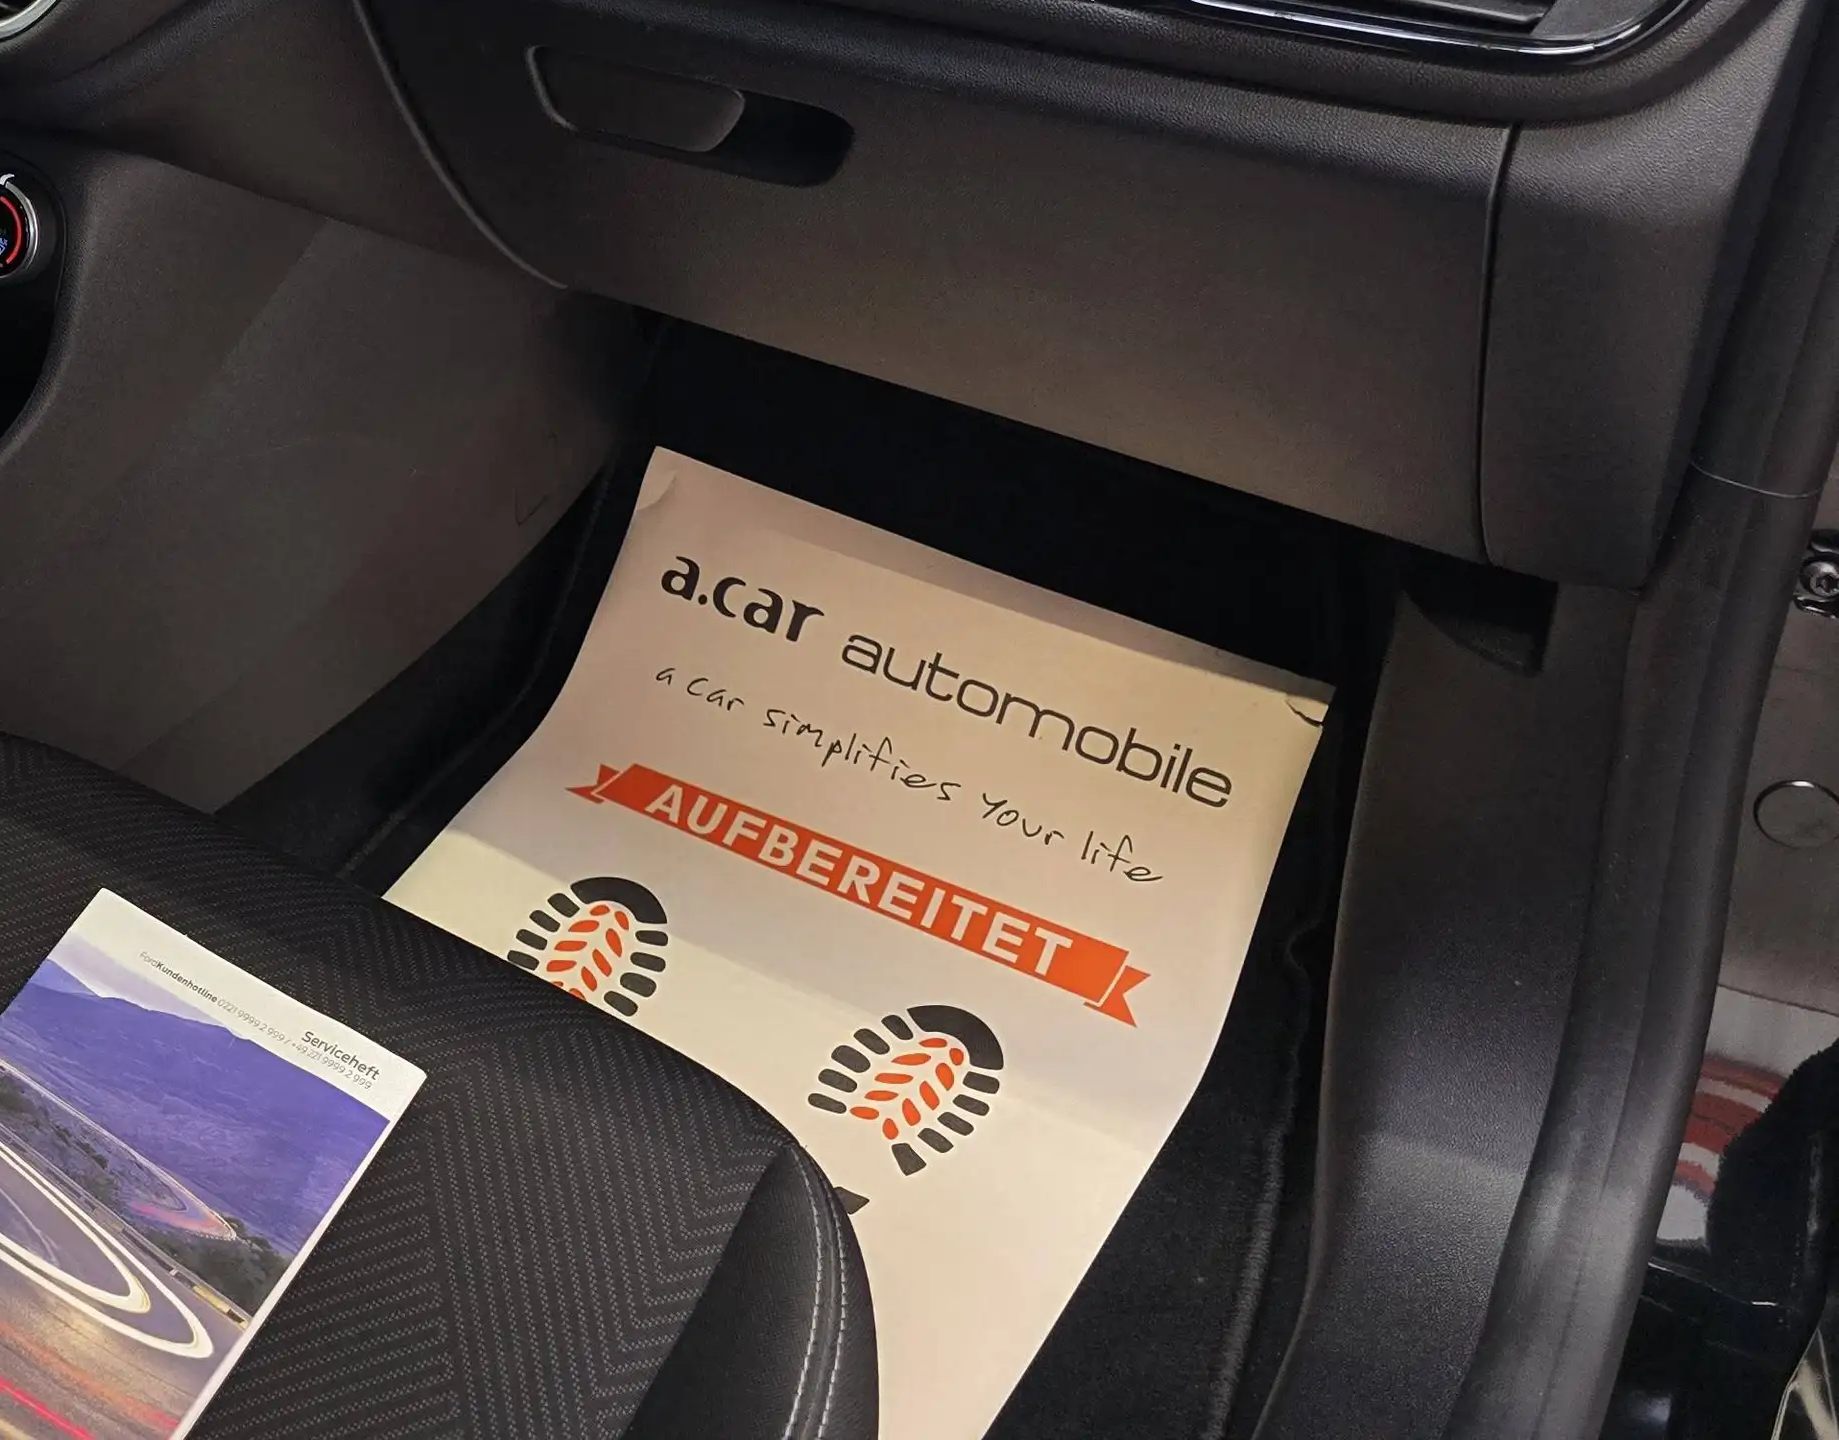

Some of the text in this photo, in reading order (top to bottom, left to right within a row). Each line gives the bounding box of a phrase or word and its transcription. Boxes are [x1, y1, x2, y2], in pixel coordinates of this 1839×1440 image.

[655, 667, 676, 687] a
[686, 677, 745, 711] car
[762, 708, 962, 802] simplifies
[1080, 830, 1164, 884] life
[660, 555, 1233, 809] a.car automobile
[643, 785, 1074, 978] AUFBEREITET
[217, 998, 238, 1015] 0221
[237, 1008, 261, 1028] 9999
[258, 1023, 268, 1032] 2
[267, 1027, 287, 1042] 999
[321, 1056, 347, 1074] 9999
[344, 1069, 354, 1080] 2
[353, 1073, 373, 1090] 999
[301, 1030, 381, 1081] Serviceheft
